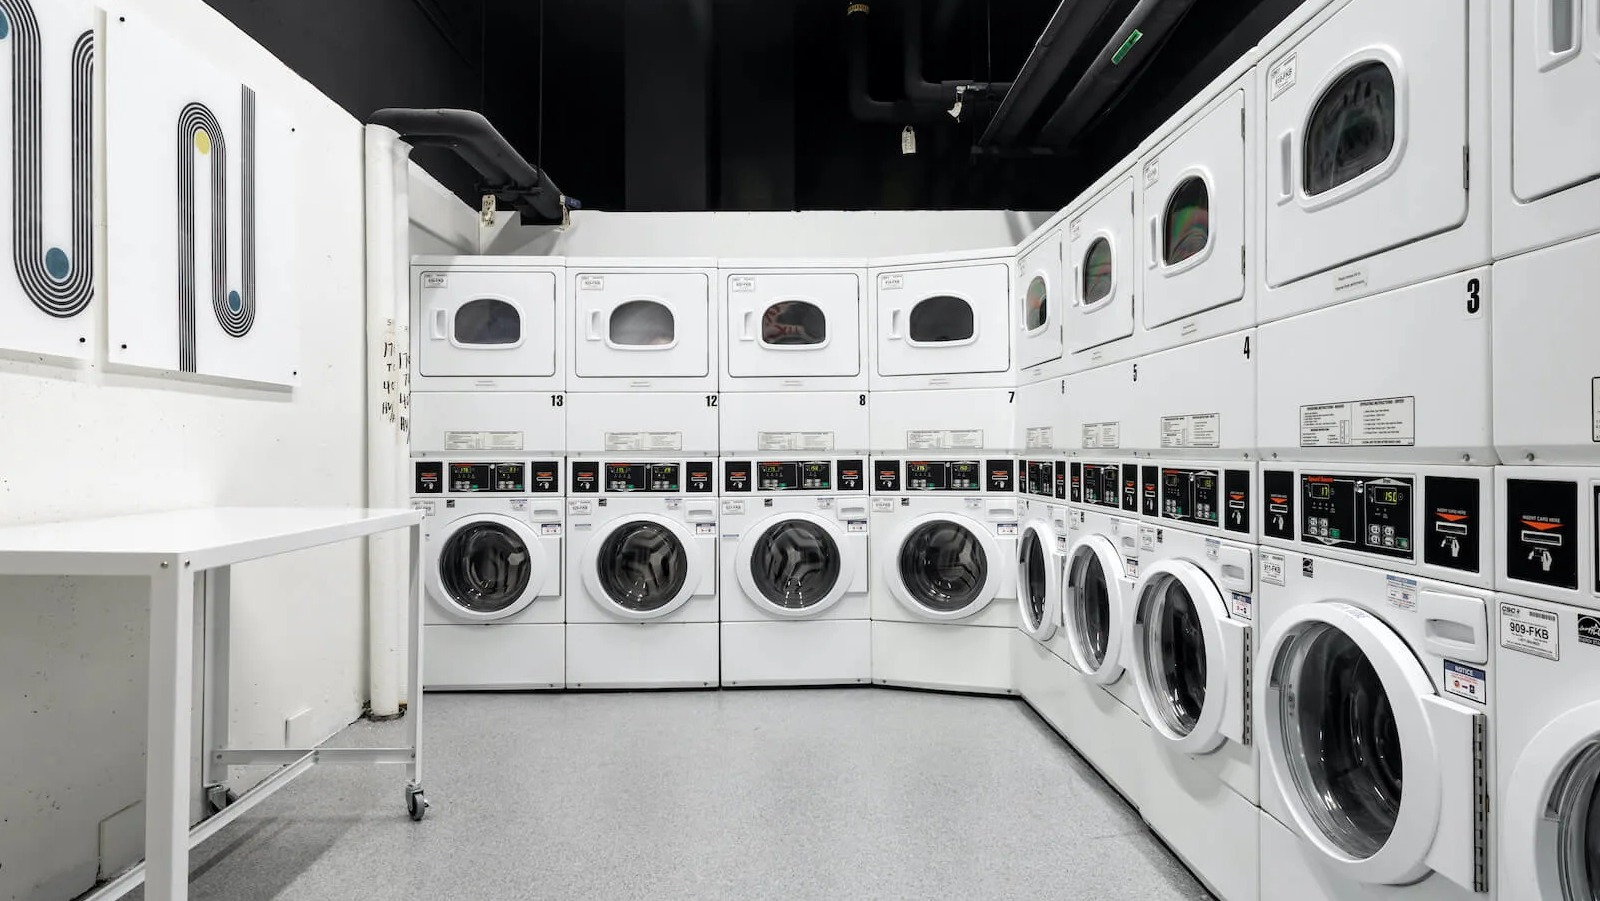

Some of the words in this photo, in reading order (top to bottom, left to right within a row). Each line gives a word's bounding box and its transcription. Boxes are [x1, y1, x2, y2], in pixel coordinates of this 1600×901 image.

[1467, 278, 1480, 314] 3
[1243, 336, 1250, 360] 4
[1133, 363, 1138, 382] 5
[551, 395, 564, 407] 13
[705, 395, 718, 407] 12
[859, 394, 866, 406] 8
[1008, 391, 1015, 404] 7
[1501, 606, 1516, 614] CSC
[1509, 621, 1549, 640] 909-FKB
[1454, 665, 1474, 676] NOTICE
